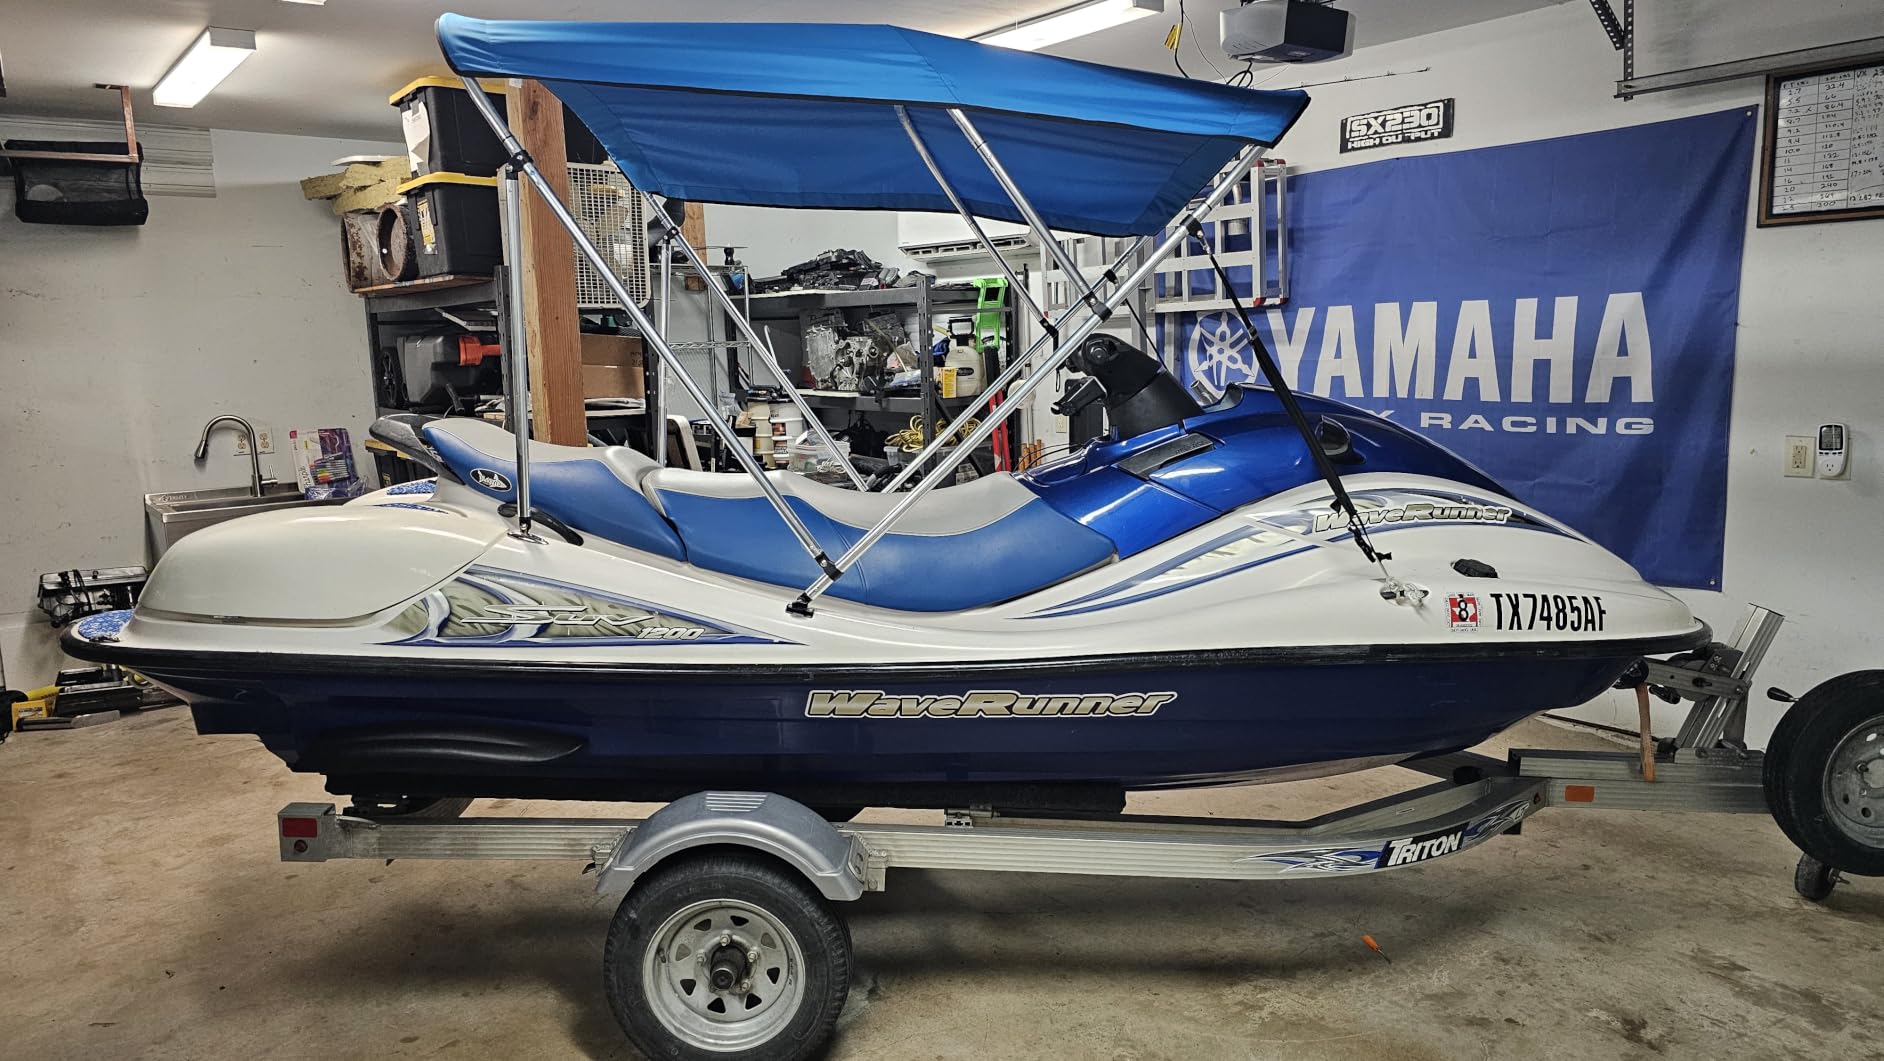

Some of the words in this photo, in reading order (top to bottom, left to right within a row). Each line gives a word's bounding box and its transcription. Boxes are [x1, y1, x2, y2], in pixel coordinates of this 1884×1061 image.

[1351, 107, 1439, 137] SX230
[1348, 137, 1380, 149] HIGH
[1266, 292, 1654, 403] YAMAHA
[1420, 411, 1654, 435] RACING
[1490, 593, 1606, 632] TX7485AF
[637, 627, 705, 640] 1200
[805, 690, 1178, 719] WaveRunner
[1387, 831, 1463, 866] TRITON
